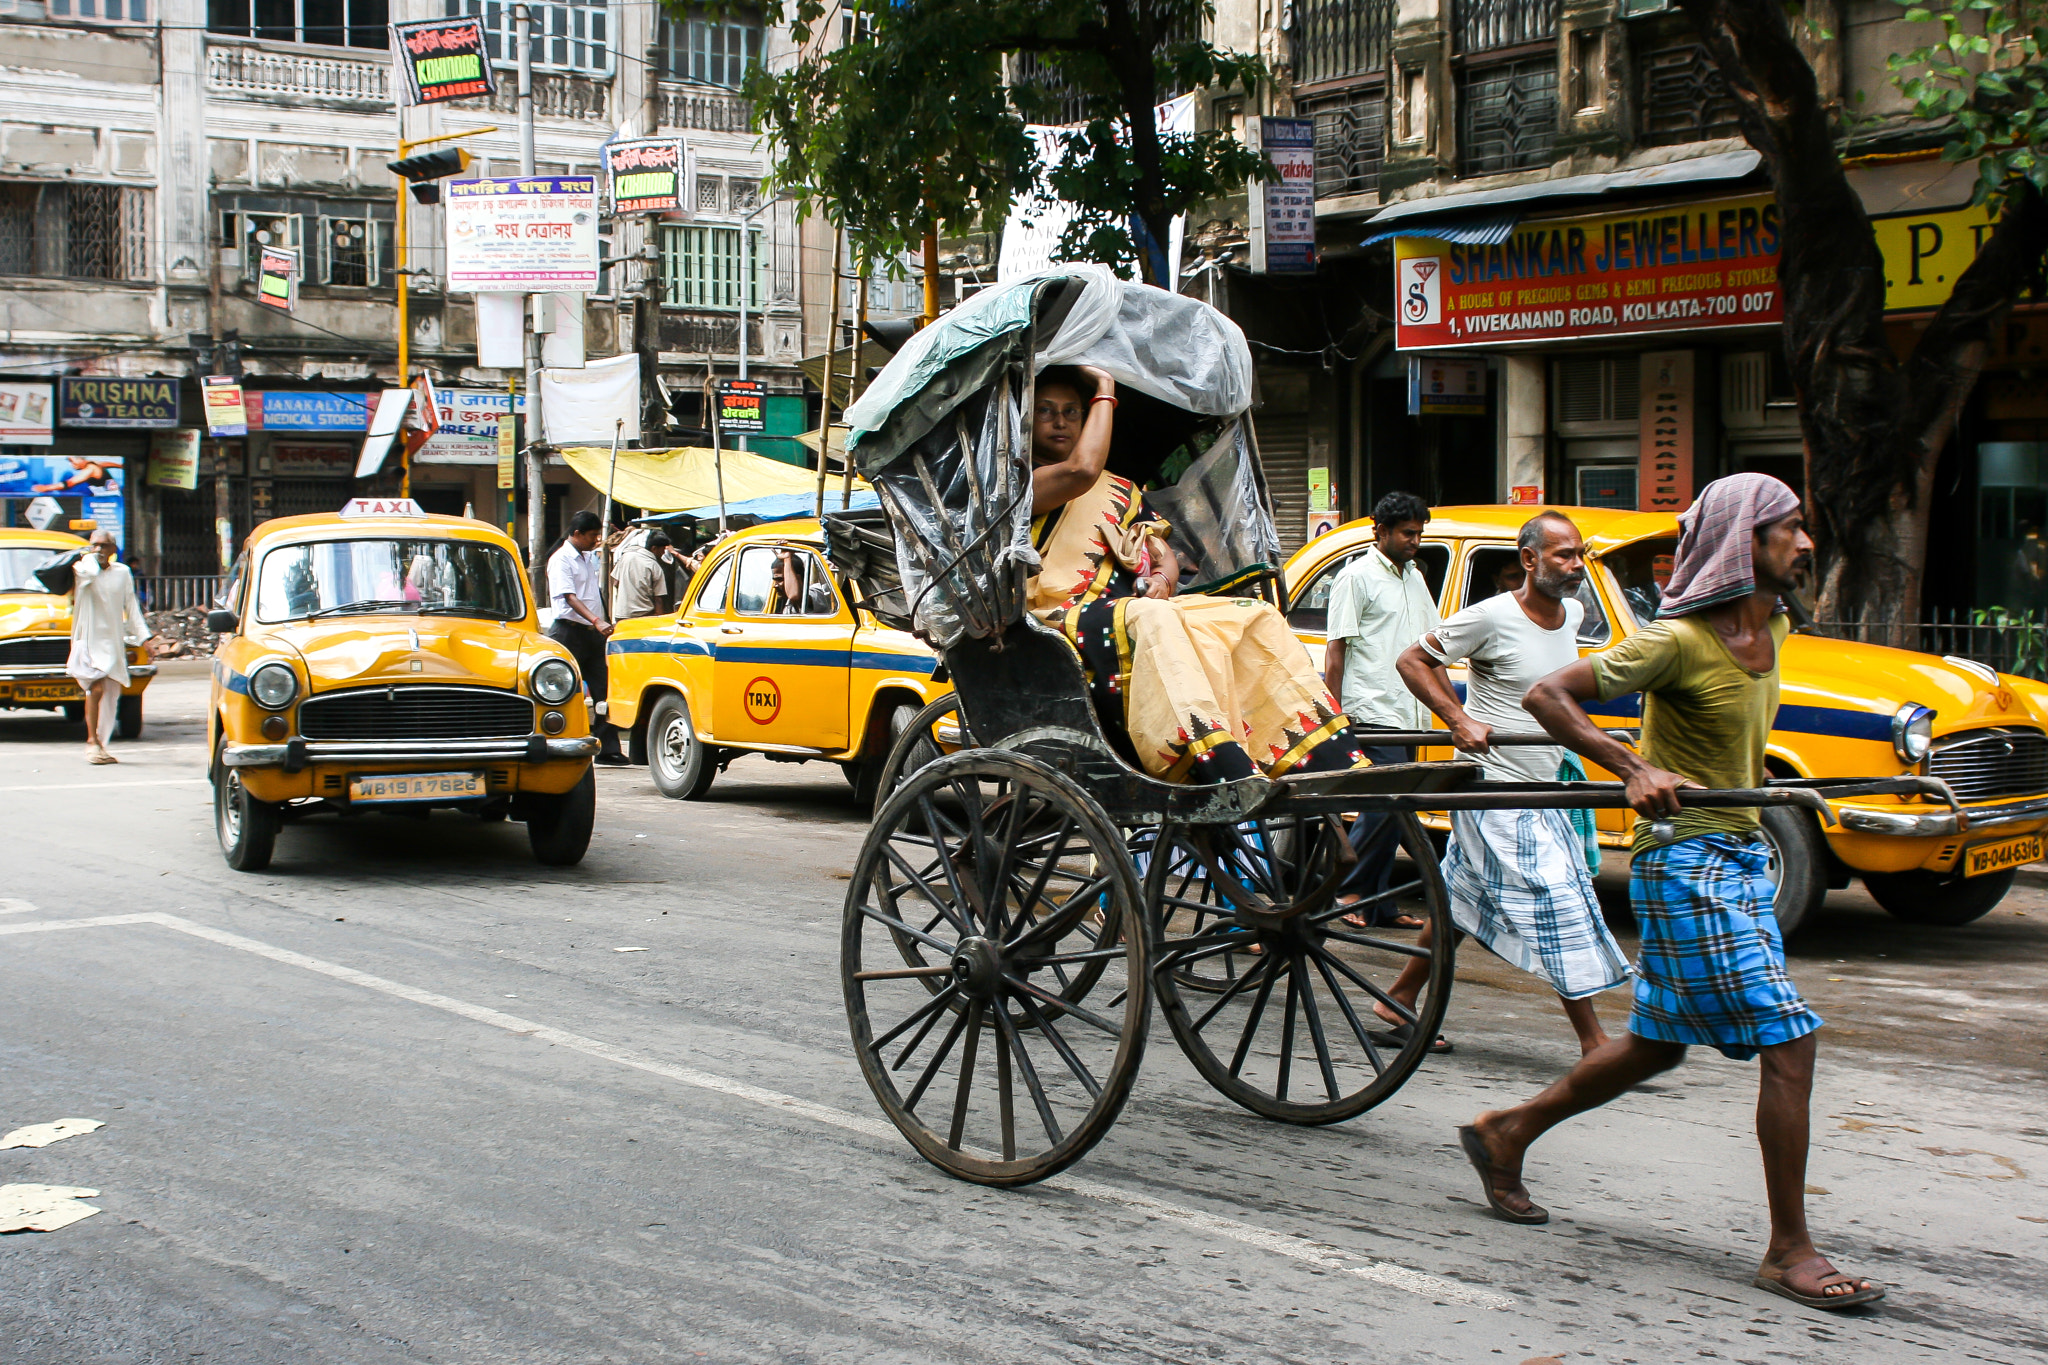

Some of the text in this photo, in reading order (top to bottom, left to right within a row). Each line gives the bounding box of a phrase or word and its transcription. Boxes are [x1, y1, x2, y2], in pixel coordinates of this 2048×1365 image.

[416, 54, 480, 85] KOHINOOR
[429, 82, 479, 98] SAREES
[452, 180, 510, 196] নাগরিক
[559, 181, 592, 193] সংঘ
[616, 172, 675, 199] KOHINOOR
[625, 197, 668, 212] SAREES
[495, 222, 519, 238] সংঘ
[1450, 203, 1781, 286] SHANKAR JEWELLERS
[1447, 266, 1778, 311] A HOUSE OF PRECIOUS GEMS & SEMI PRECIOUS STONES
[1448, 291, 1775, 338] 1, VIVEKANAND ROAD, KOLKATA-700 007
[69, 380, 176, 405] KRISHNA
[263, 399, 366, 412] JANAKALYAN
[723, 394, 760, 408] संगम
[105, 404, 140, 417] TEA
[263, 413, 366, 426] MEDICAL STORES
[436, 425, 476, 435] HREE
[355, 501, 411, 514] TAXI
[749, 692, 776, 707] TAXI
